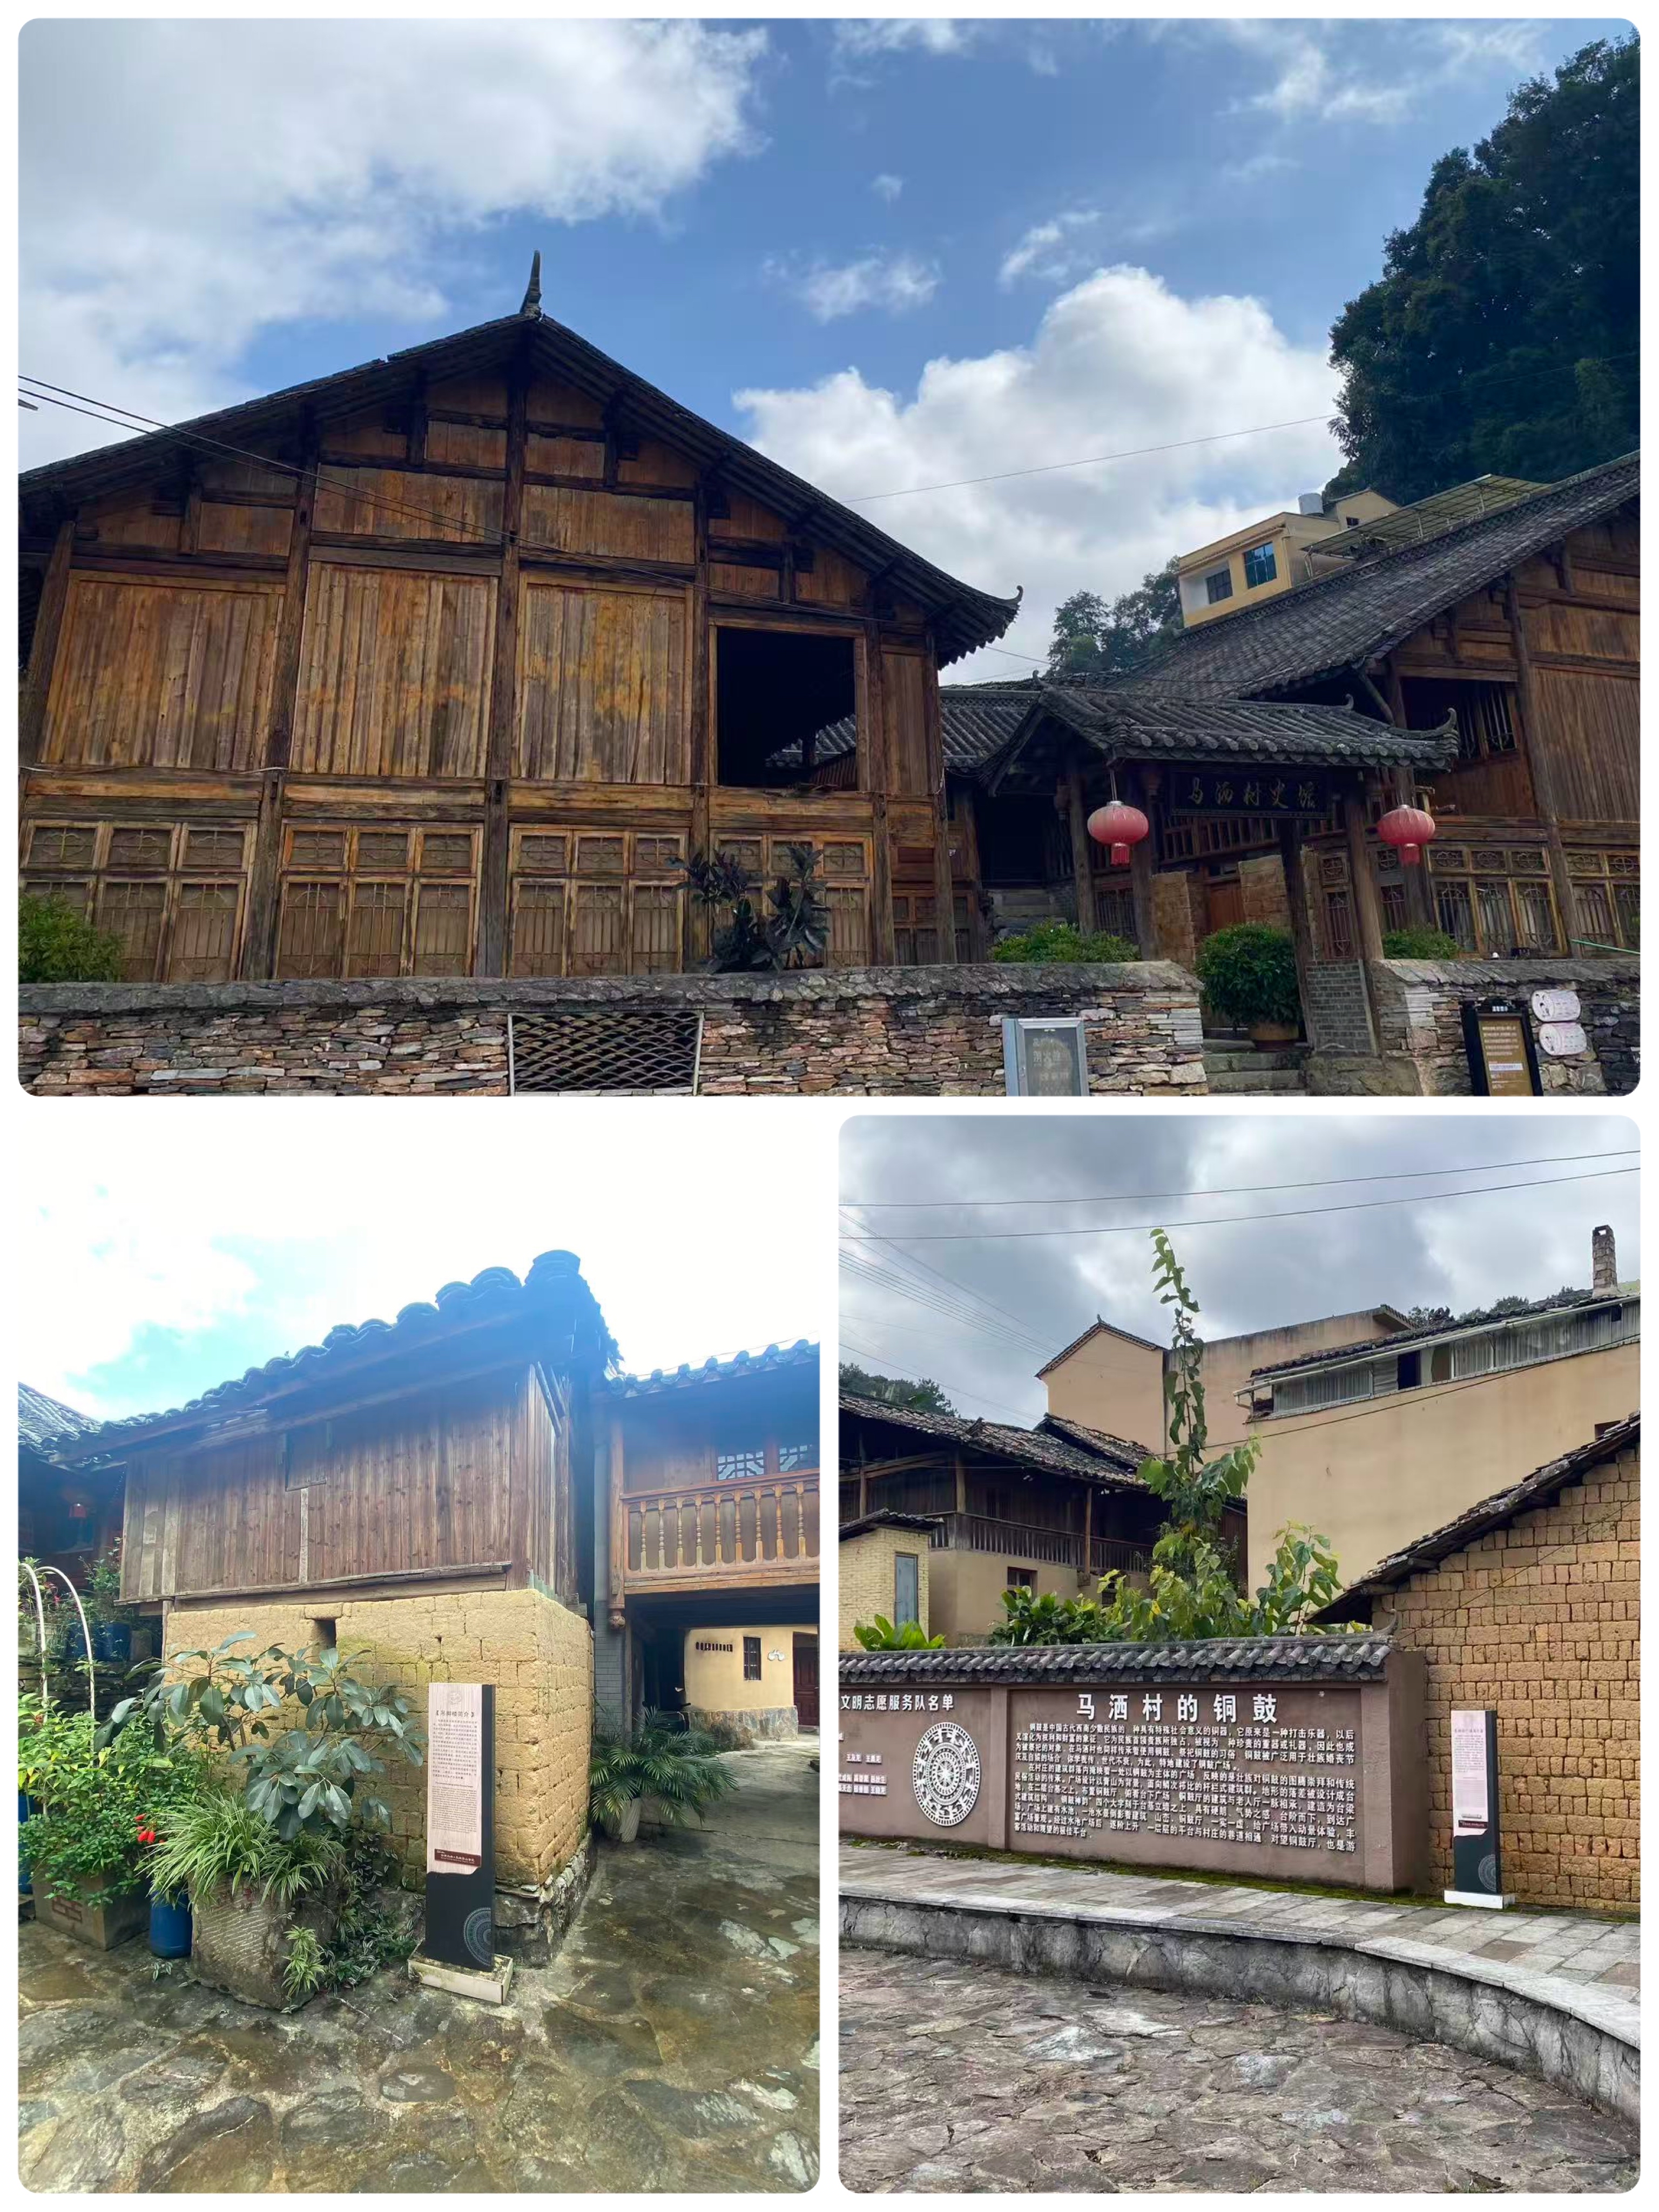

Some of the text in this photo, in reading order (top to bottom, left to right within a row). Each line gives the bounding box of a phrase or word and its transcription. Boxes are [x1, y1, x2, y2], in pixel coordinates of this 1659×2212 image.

[841, 1694, 954, 1711] 文明志愿服务队名单
[1076, 1694, 1278, 1723] 马洒村的铜鼓
